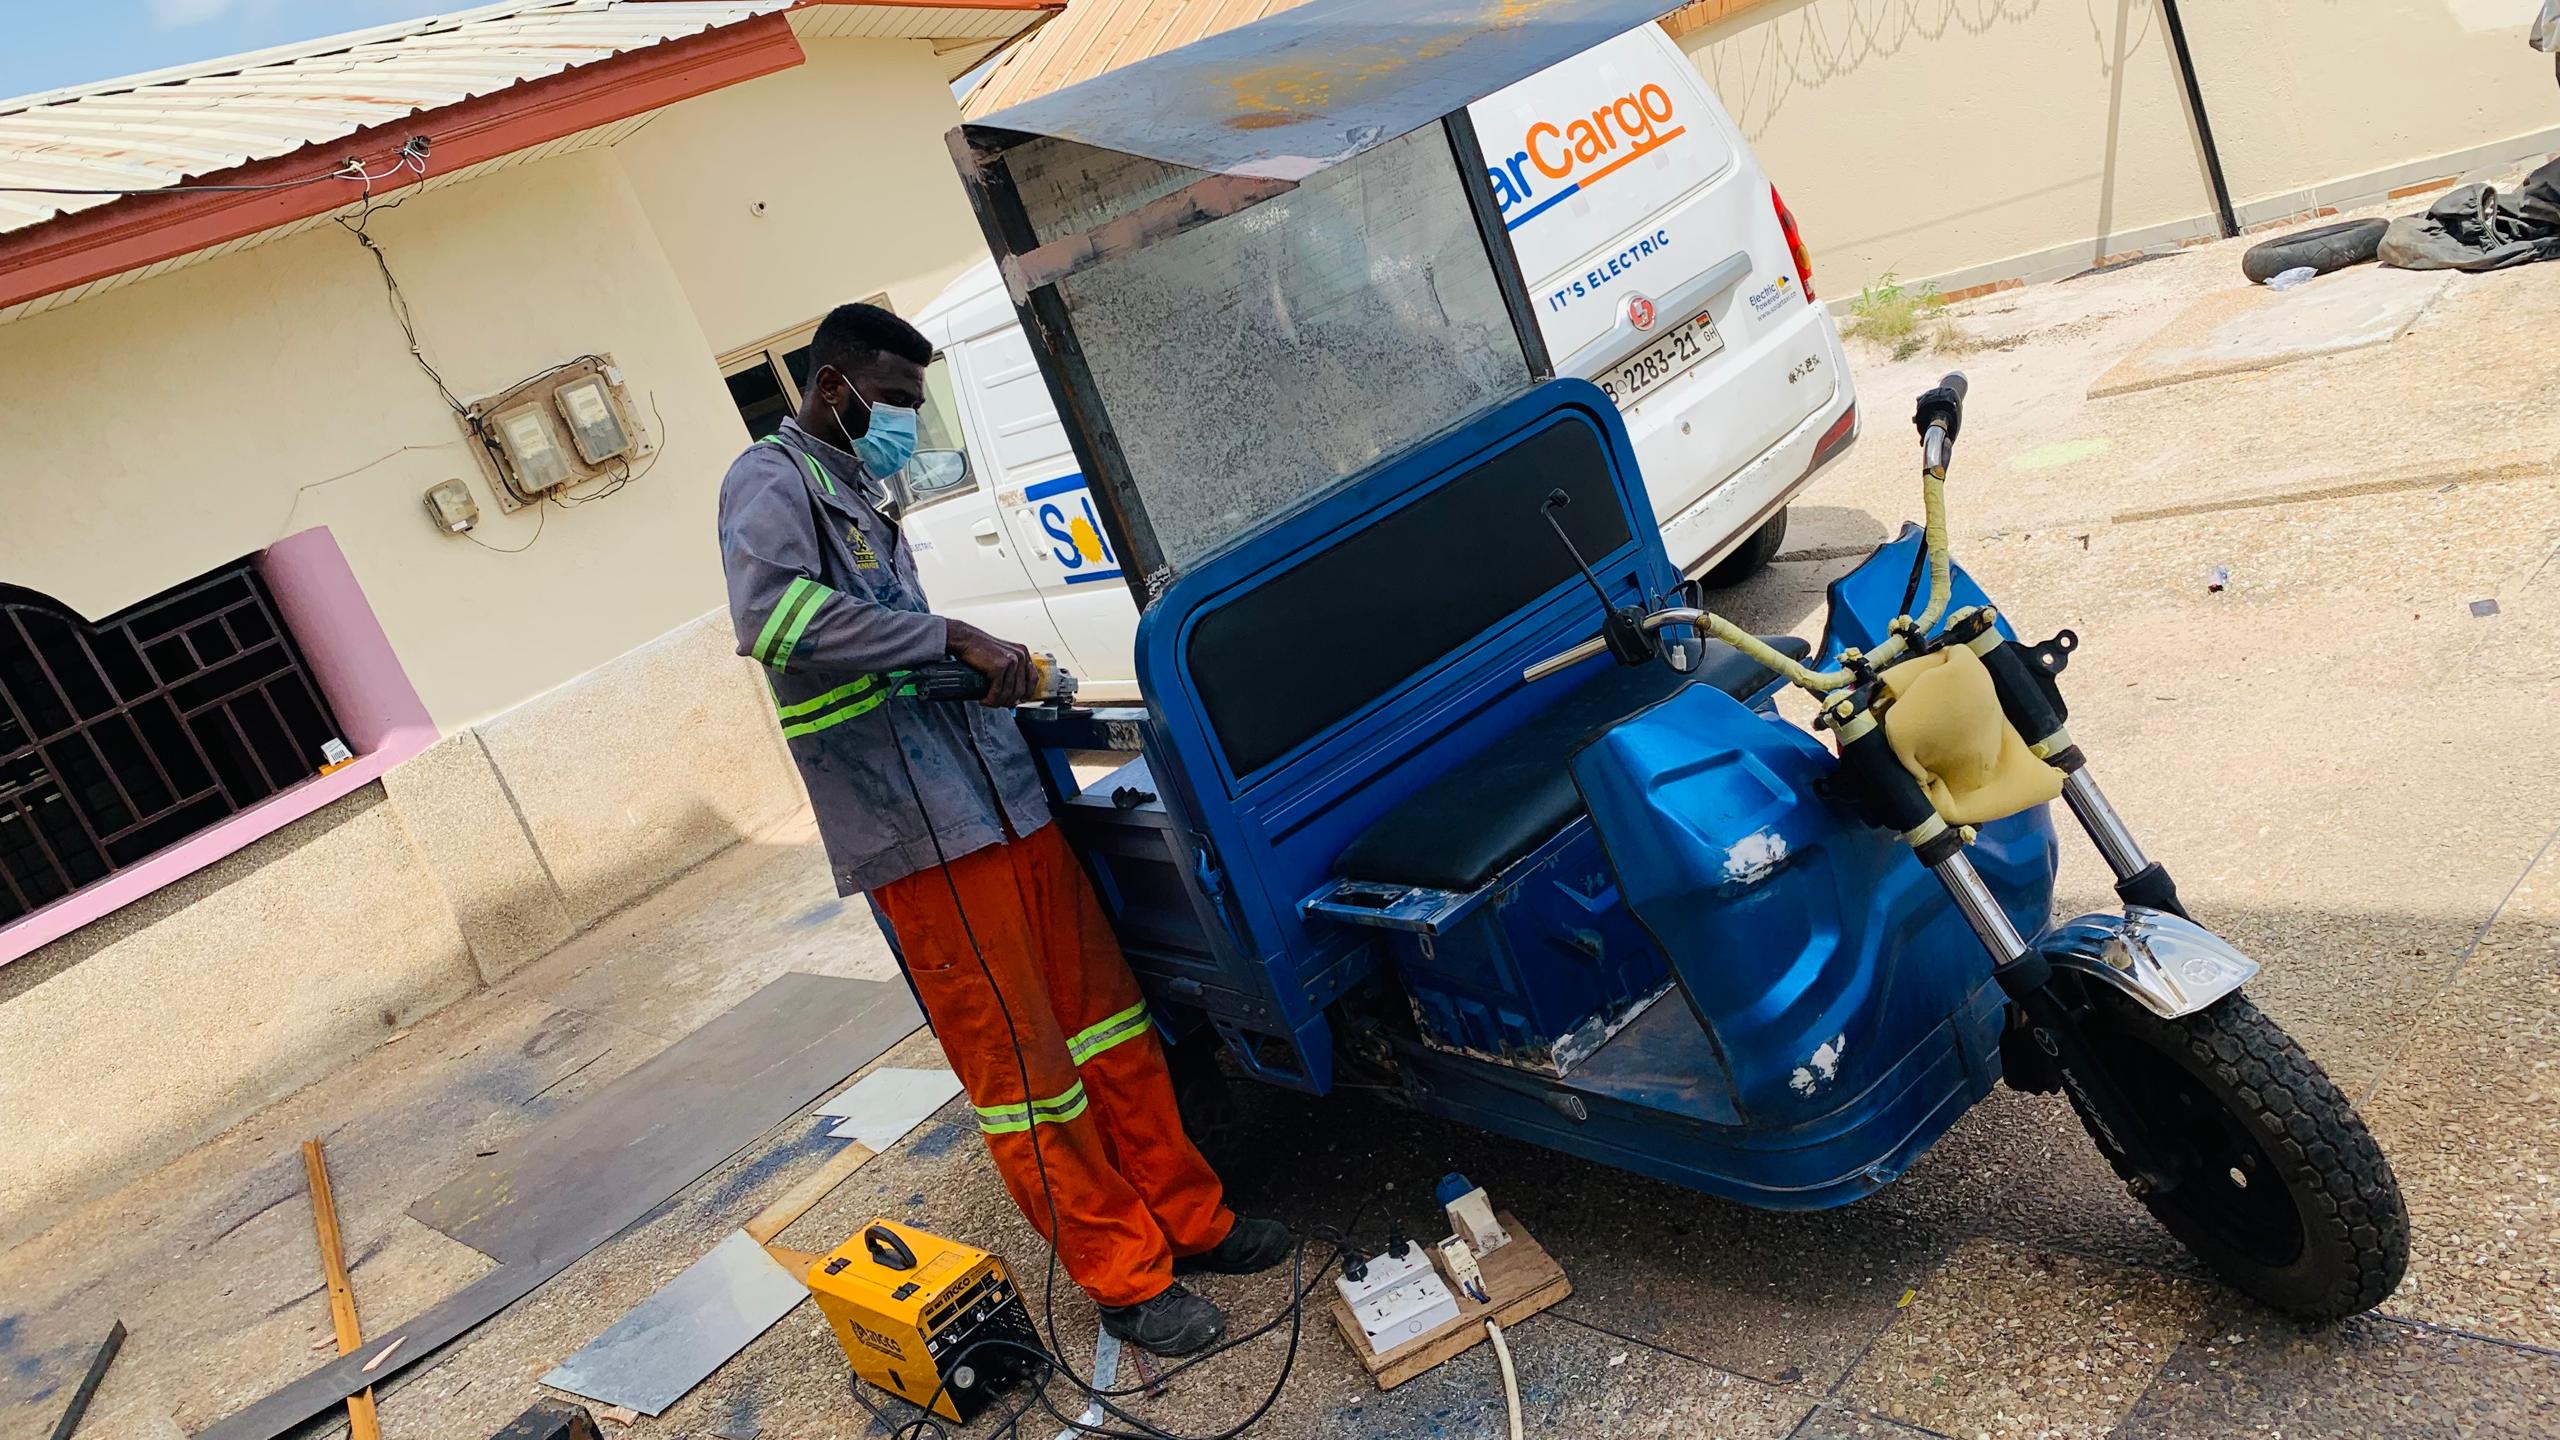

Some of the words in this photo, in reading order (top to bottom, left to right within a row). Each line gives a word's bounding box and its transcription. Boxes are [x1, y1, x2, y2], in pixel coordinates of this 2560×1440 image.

[1549, 284, 1585, 312] IT'S
[1589, 229, 1670, 288] ELECTRIC
[1749, 282, 1777, 306] Electric
[1755, 293, 1781, 312] Powered
[1624, 331, 1701, 393] 2283-21
[1703, 328, 1717, 342] GH
